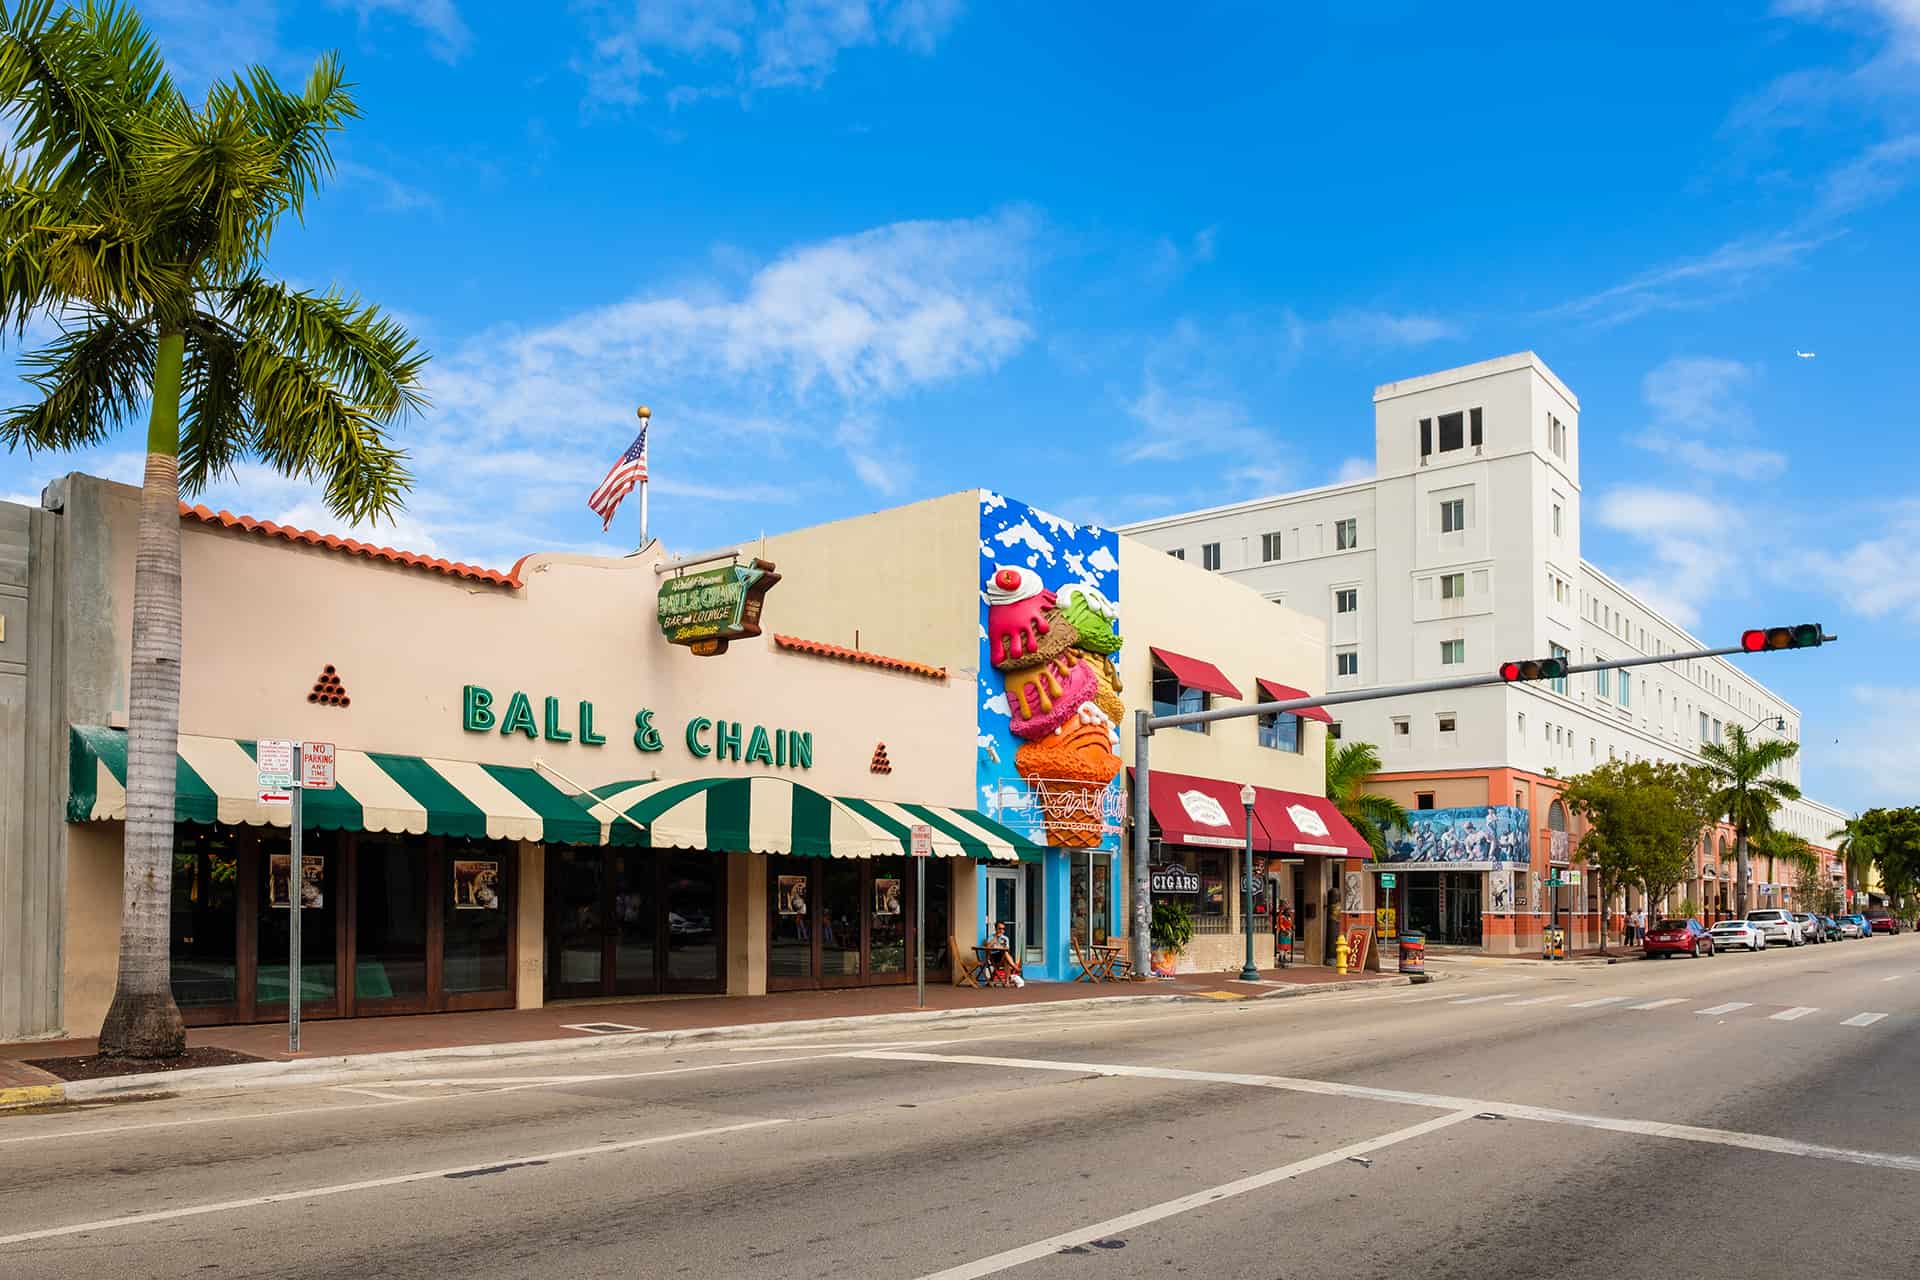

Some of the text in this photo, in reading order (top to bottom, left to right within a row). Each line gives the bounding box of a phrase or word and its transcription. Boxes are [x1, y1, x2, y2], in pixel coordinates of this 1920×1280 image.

[664, 616, 682, 629] BAR
[693, 607, 729, 623] LOUNGE
[463, 685, 814, 769] BALL & CHAIN
[312, 744, 326, 754] NO
[304, 753, 334, 764] PARKING
[1153, 875, 1198, 891] CIGARS
